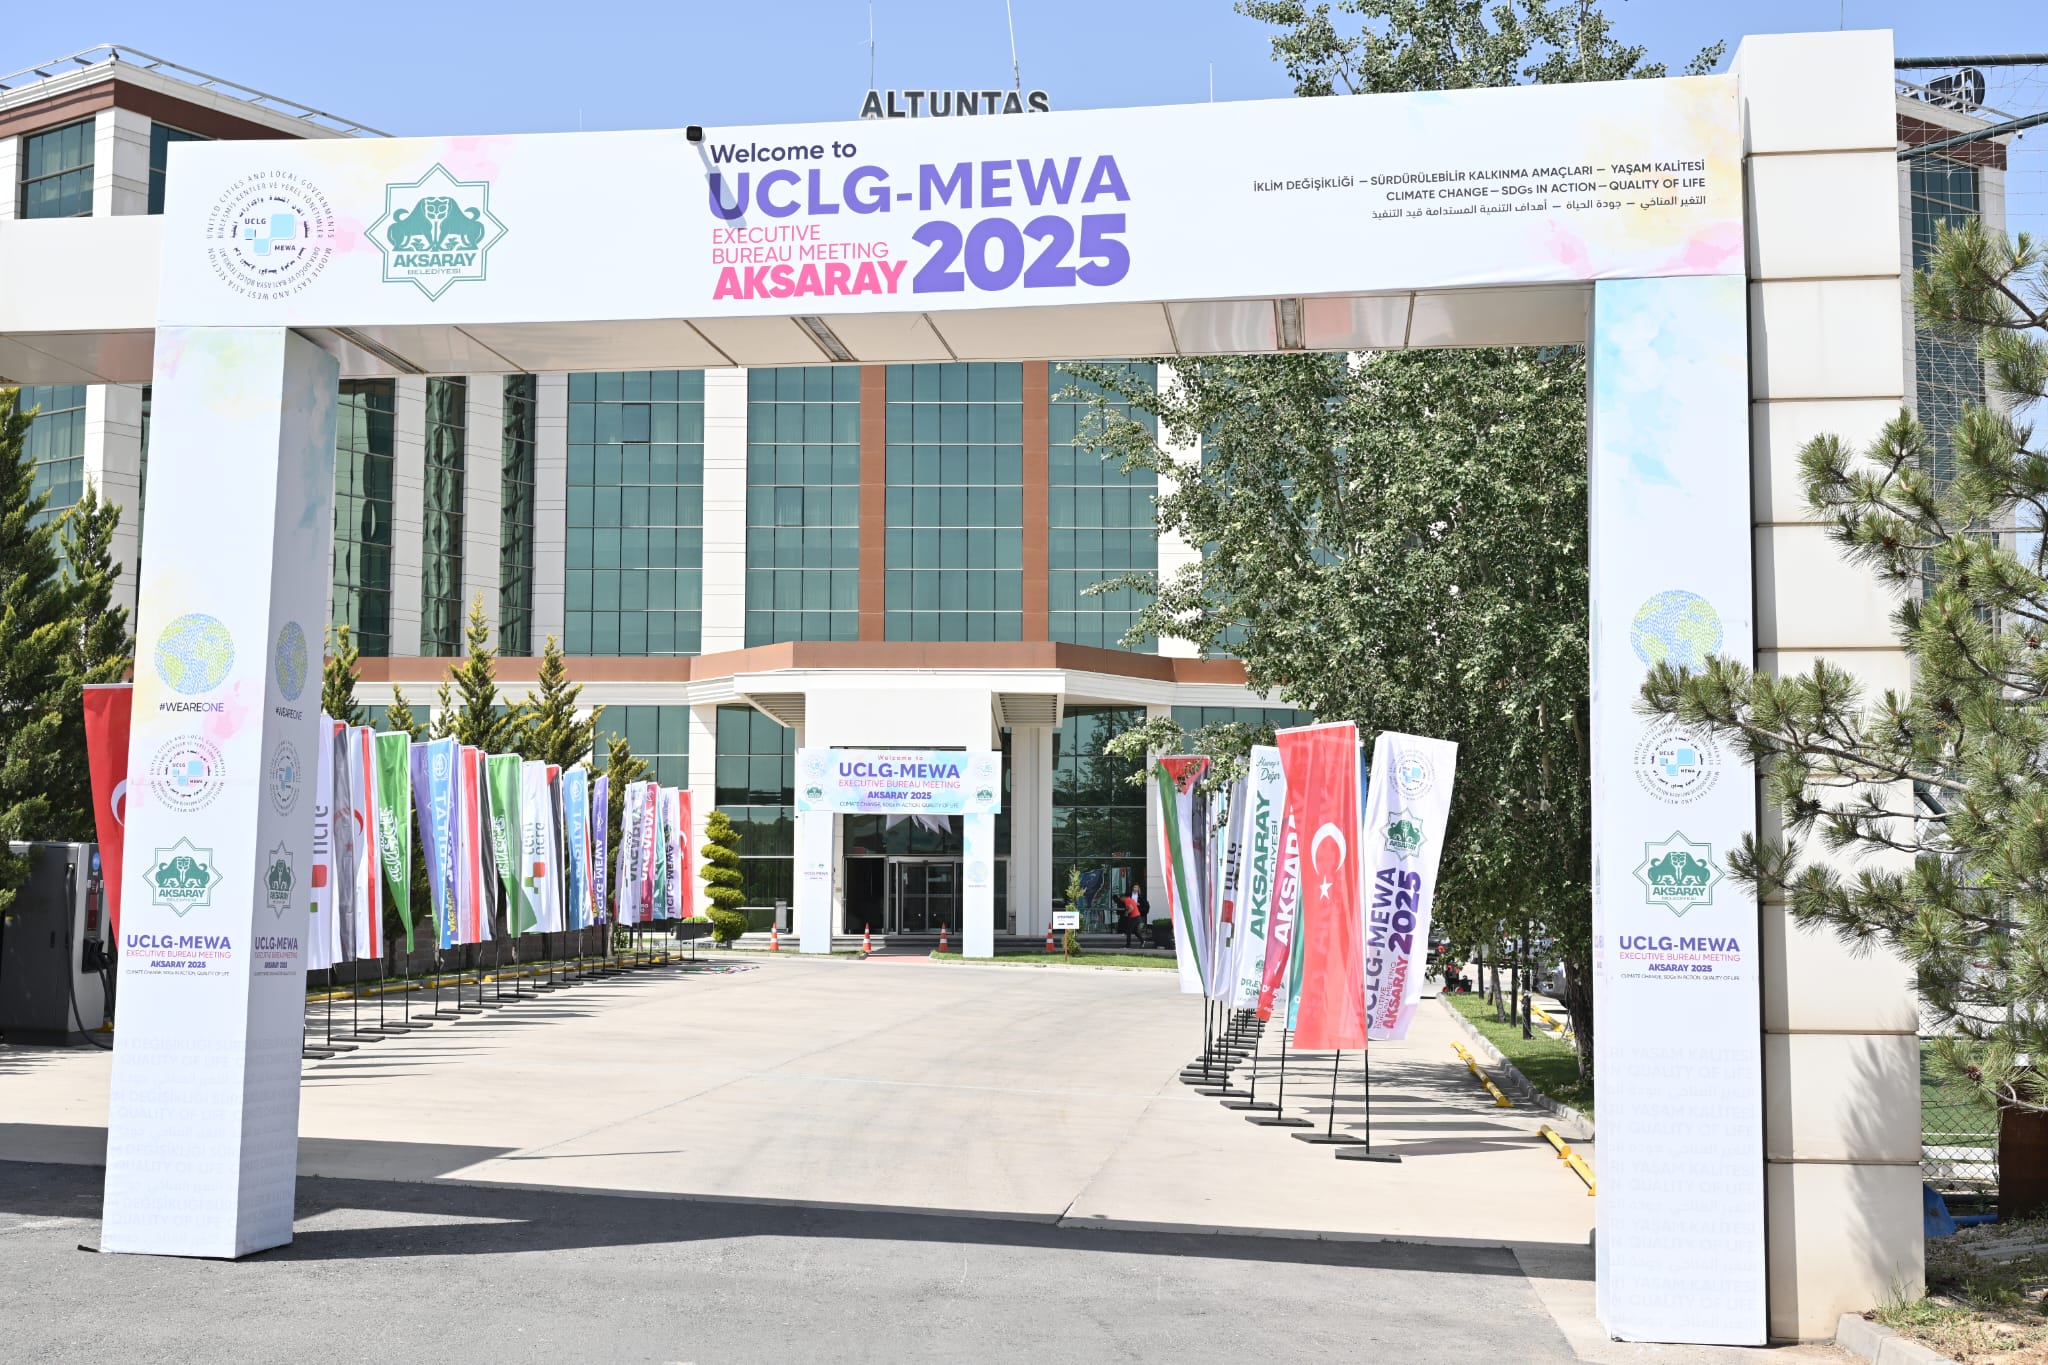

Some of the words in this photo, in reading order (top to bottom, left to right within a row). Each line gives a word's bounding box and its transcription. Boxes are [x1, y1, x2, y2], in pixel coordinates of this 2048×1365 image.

[711, 142, 824, 164] Welcome
[832, 141, 857, 159] to
[1253, 180, 1283, 192] İKLİM
[1286, 175, 1354, 191] DEĞİŞİKLİĞİ
[1370, 170, 1466, 185] SÜRDÜRÜLEBİLİR
[1469, 169, 1529, 182] KALKINMA
[1532, 166, 1593, 178] AMAÇLARI
[1611, 163, 1651, 175] YAŞAM
[1655, 159, 1705, 172] KALİTESİ
[708, 154, 1131, 220] UCLG-MEWA
[1386, 190, 1435, 201] CLIMATE
[1438, 187, 1488, 198] CHANGE
[1501, 186, 1533, 196] SDGs
[1536, 185, 1548, 194] IN
[1551, 182, 1596, 193] ACTION
[1609, 180, 1659, 191] QUALITY
[1663, 179, 1679, 188] OF
[1683, 178, 1706, 188] LIFE
[712, 224, 821, 245] EXECUTIVE
[393, 253, 477, 268] AKSARAY
[712, 245, 792, 265] BUREAU
[799, 242, 889, 263] MEETING
[712, 260, 908, 300] AKSARAY
[911, 213, 1131, 294] 2025
[159, 702, 224, 713] #WEAREONE
[839, 762, 960, 779] UCLG-MEWA
[887, 780, 920, 788] BUREAU
[923, 781, 960, 789] MEETING
[867, 791, 908, 800] AKSARAY
[910, 792, 932, 800] 2025
[1250, 790, 1270, 940] AKSARAY
[159, 889, 205, 898] AKSARAY
[1652, 887, 1706, 896] AKSARAY
[1388, 870, 1421, 954] 2025
[127, 934, 231, 950] UCLG-MEWA
[1619, 935, 1740, 952] UCLG-MEWA
[167, 950, 196, 958] BUREAU
[198, 951, 231, 959] MEETING
[1619, 952, 1665, 960] EXECUTIVE
[1667, 952, 1700, 961] BUREAU
[1702, 953, 1740, 962] MEETING
[150, 960, 186, 968] AKSARAY
[1648, 963, 1689, 972] AKSARAY
[1691, 964, 1713, 972] 2025
[1383, 955, 1408, 1030] AKSARAY
